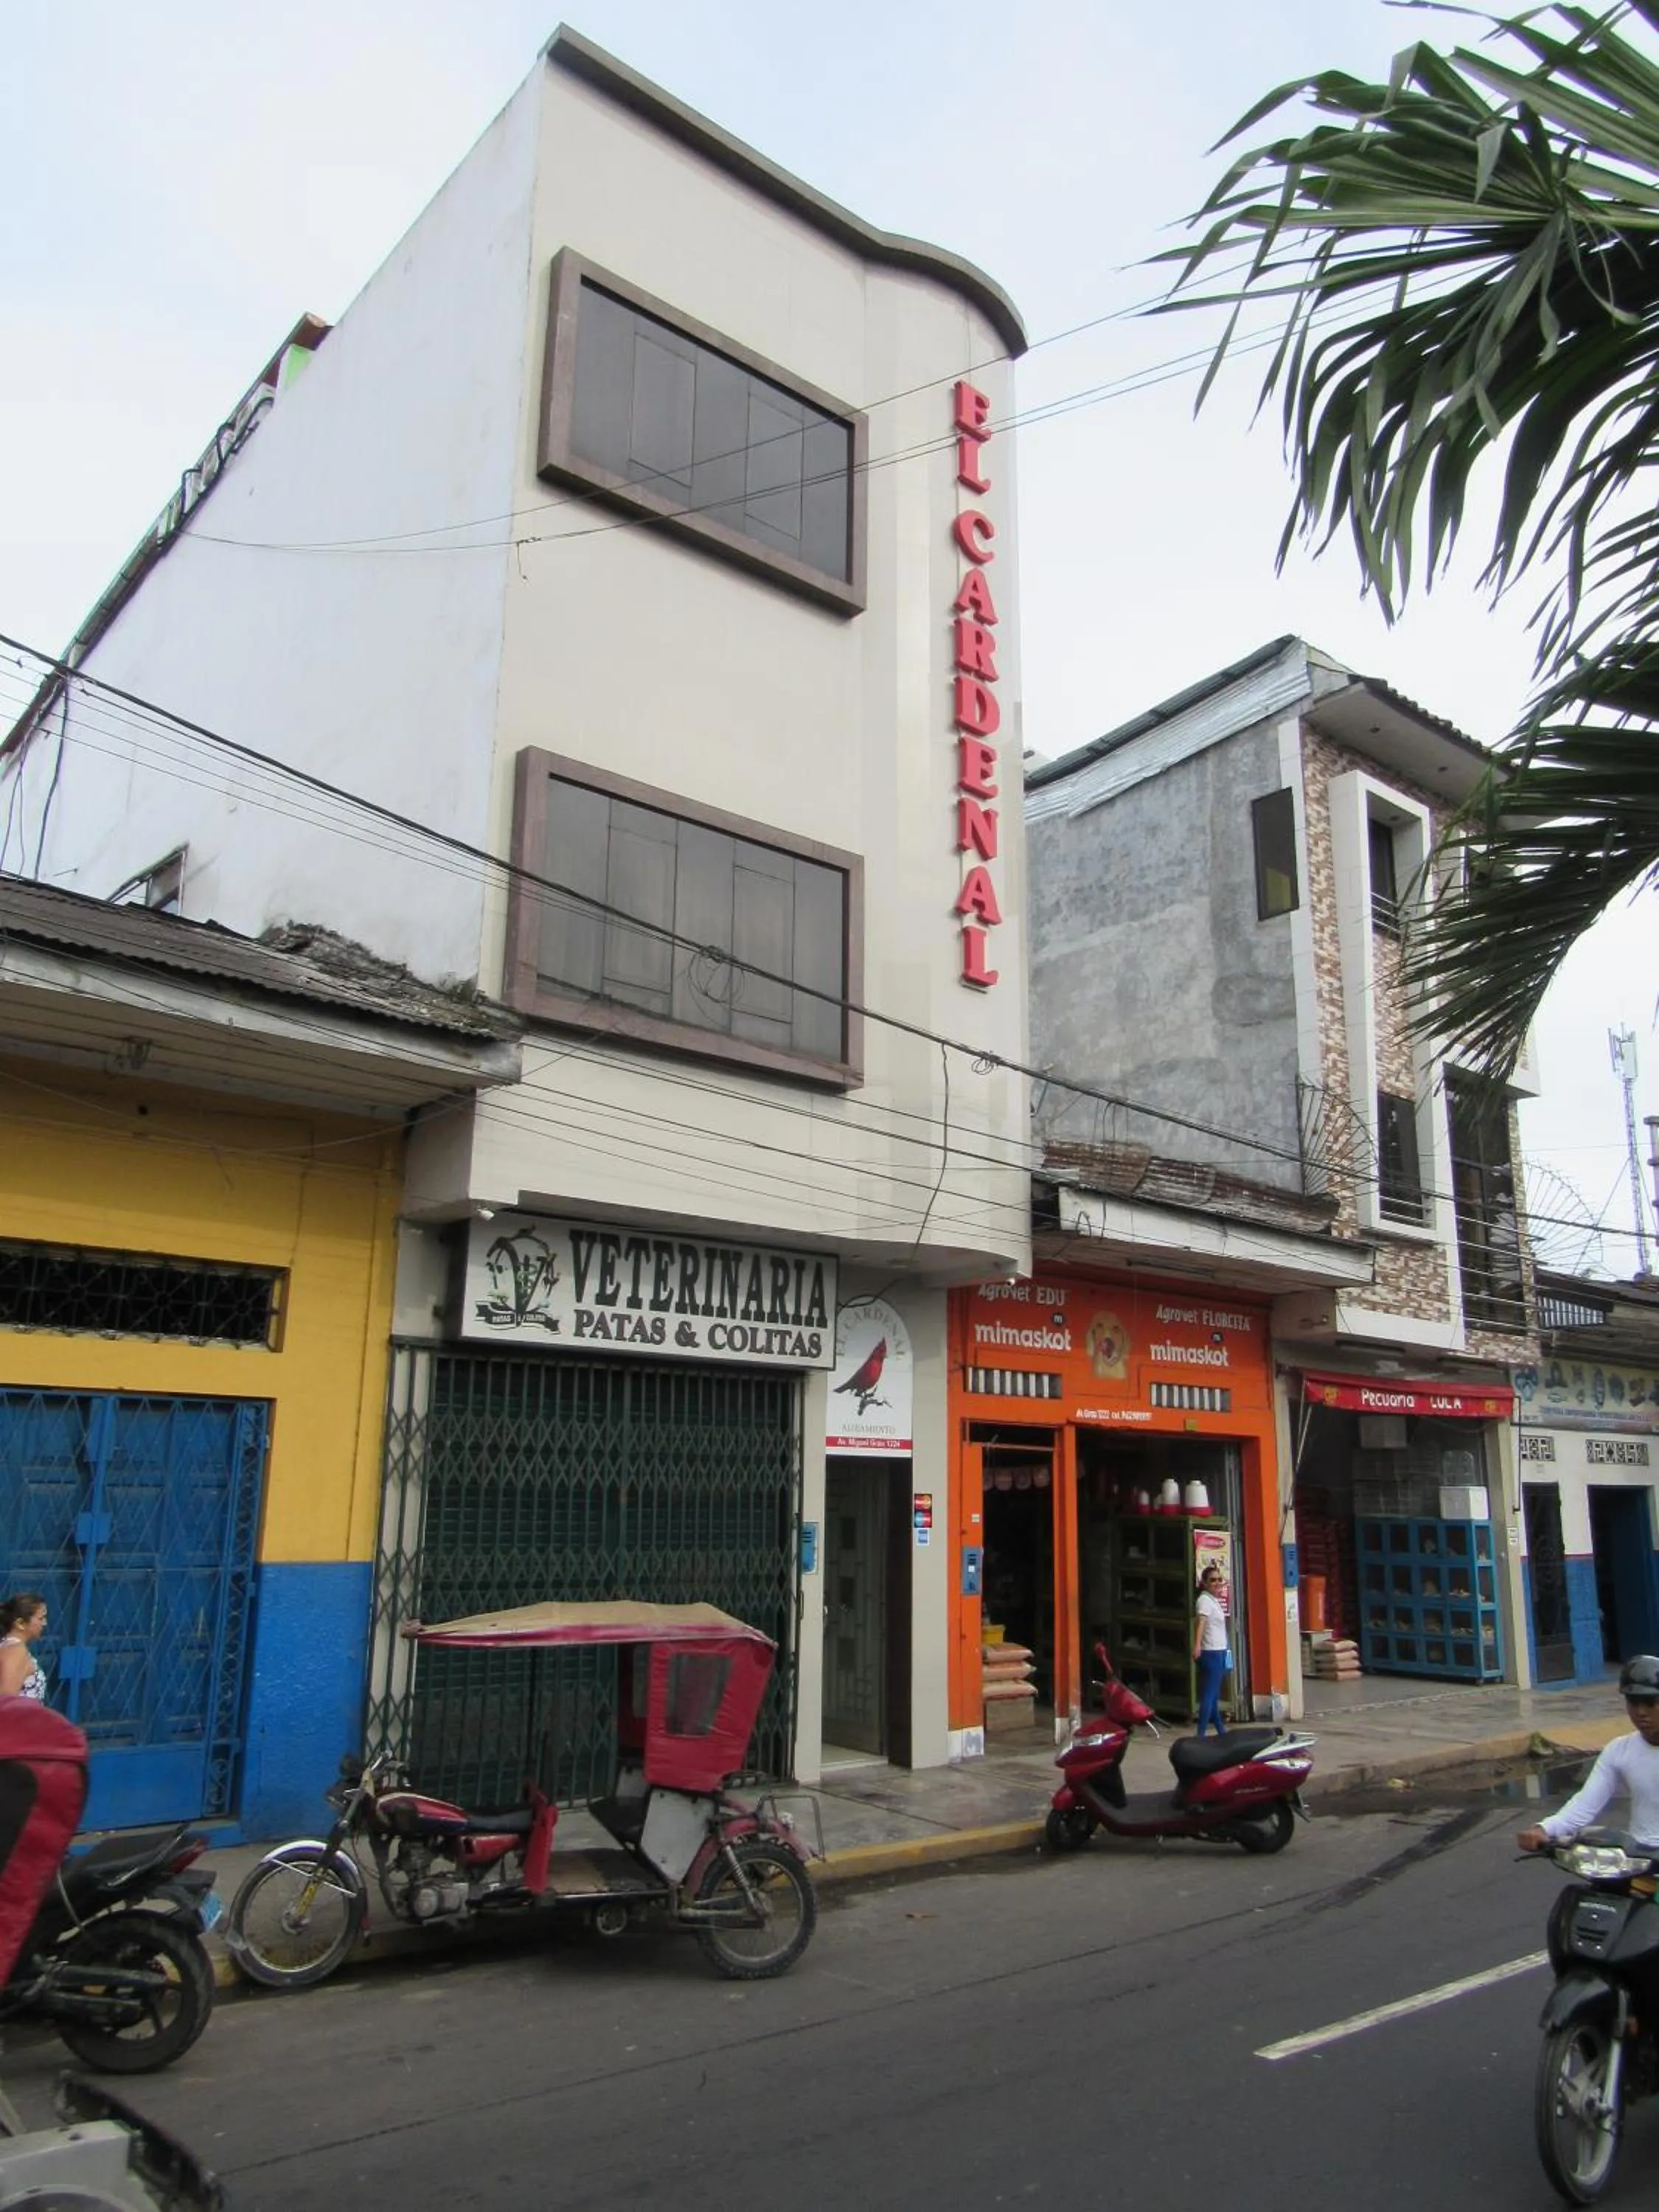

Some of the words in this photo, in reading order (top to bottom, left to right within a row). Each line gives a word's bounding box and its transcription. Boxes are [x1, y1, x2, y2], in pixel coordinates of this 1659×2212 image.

[954, 379, 992, 495] EL
[954, 509, 1001, 987] CARDENAL
[568, 1229, 827, 1328] VETERINARIA
[573, 1309, 666, 1345] PATAS
[675, 1321, 700, 1349] &
[708, 1324, 822, 1358] COLITAS
[975, 1321, 1071, 1351] mimaskot
[1155, 1304, 1197, 1324] Agrovet
[1150, 1340, 1228, 1366] mimaskot
